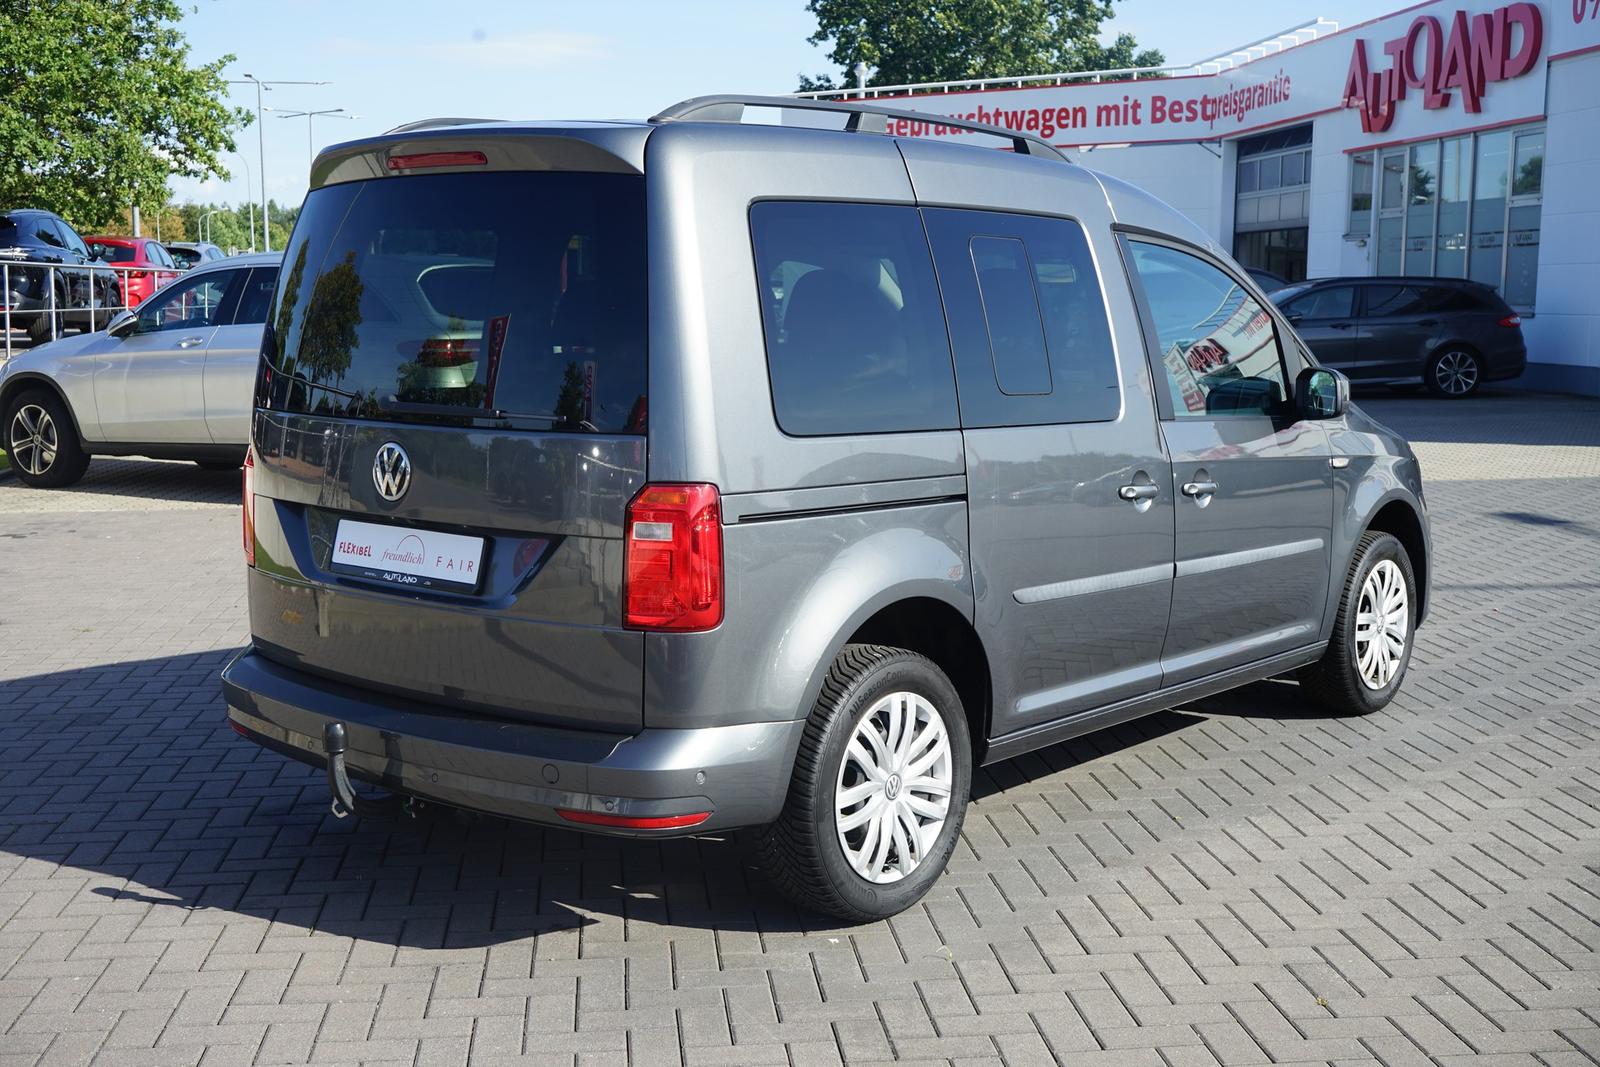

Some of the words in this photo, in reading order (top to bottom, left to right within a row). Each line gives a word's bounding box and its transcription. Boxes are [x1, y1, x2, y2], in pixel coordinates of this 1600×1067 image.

[1341, 2, 1543, 133] AUTOLAND
[1096, 95, 1141, 128] mit
[1150, 70, 1292, 130] Bestpreisgarantie
[338, 542, 372, 557] FLEXIBEL
[380, 548, 424, 565] freundlich
[435, 556, 474, 572] FAIR
